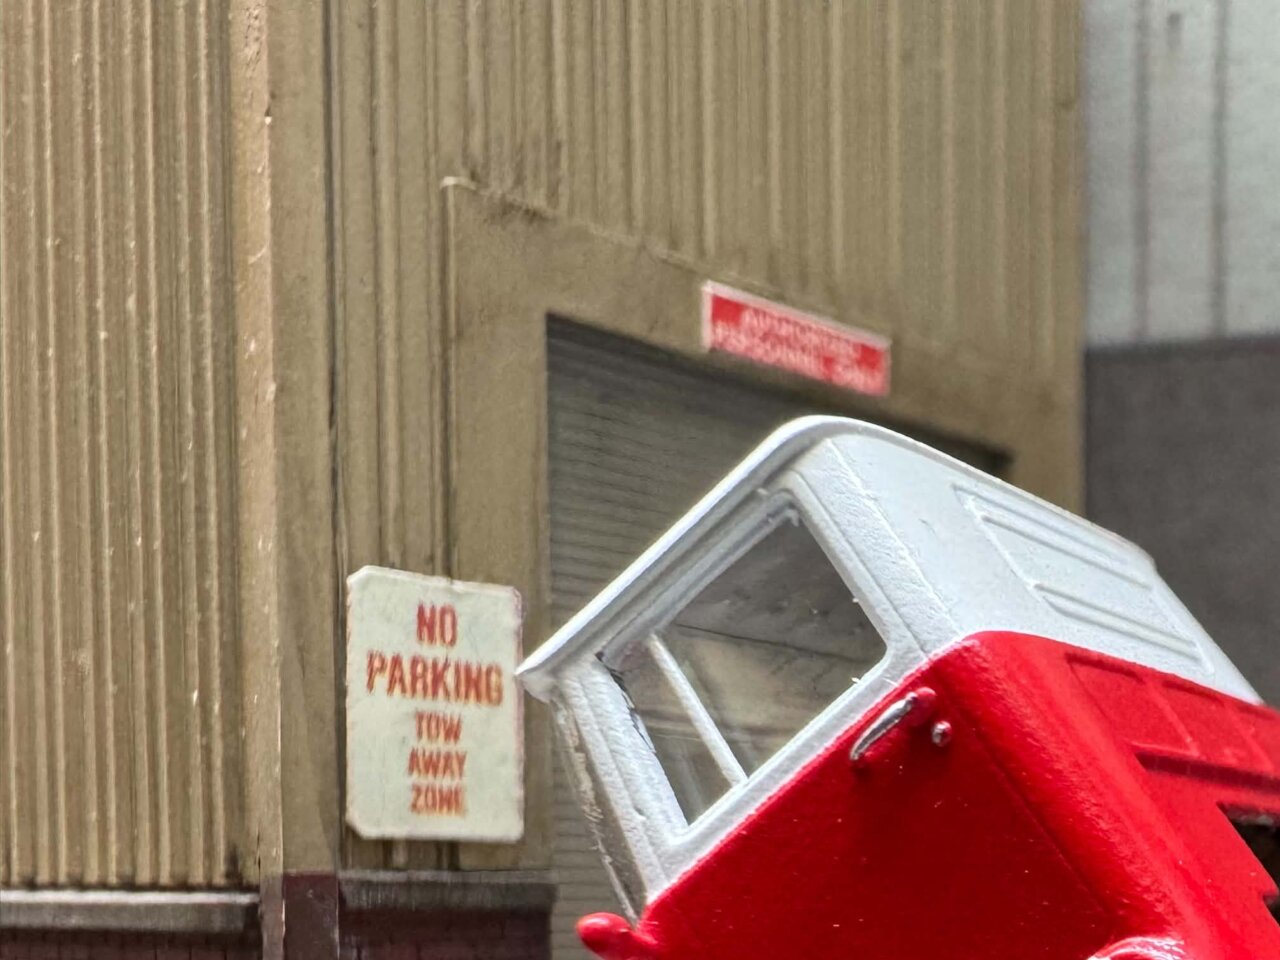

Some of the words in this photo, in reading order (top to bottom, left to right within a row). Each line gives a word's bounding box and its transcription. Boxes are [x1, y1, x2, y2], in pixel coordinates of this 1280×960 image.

[416, 603, 458, 647] NO
[366, 650, 504, 706] PARKING
[415, 710, 463, 744] TOW
[408, 748, 466, 778] AWAY
[410, 784, 465, 817] ZONE
